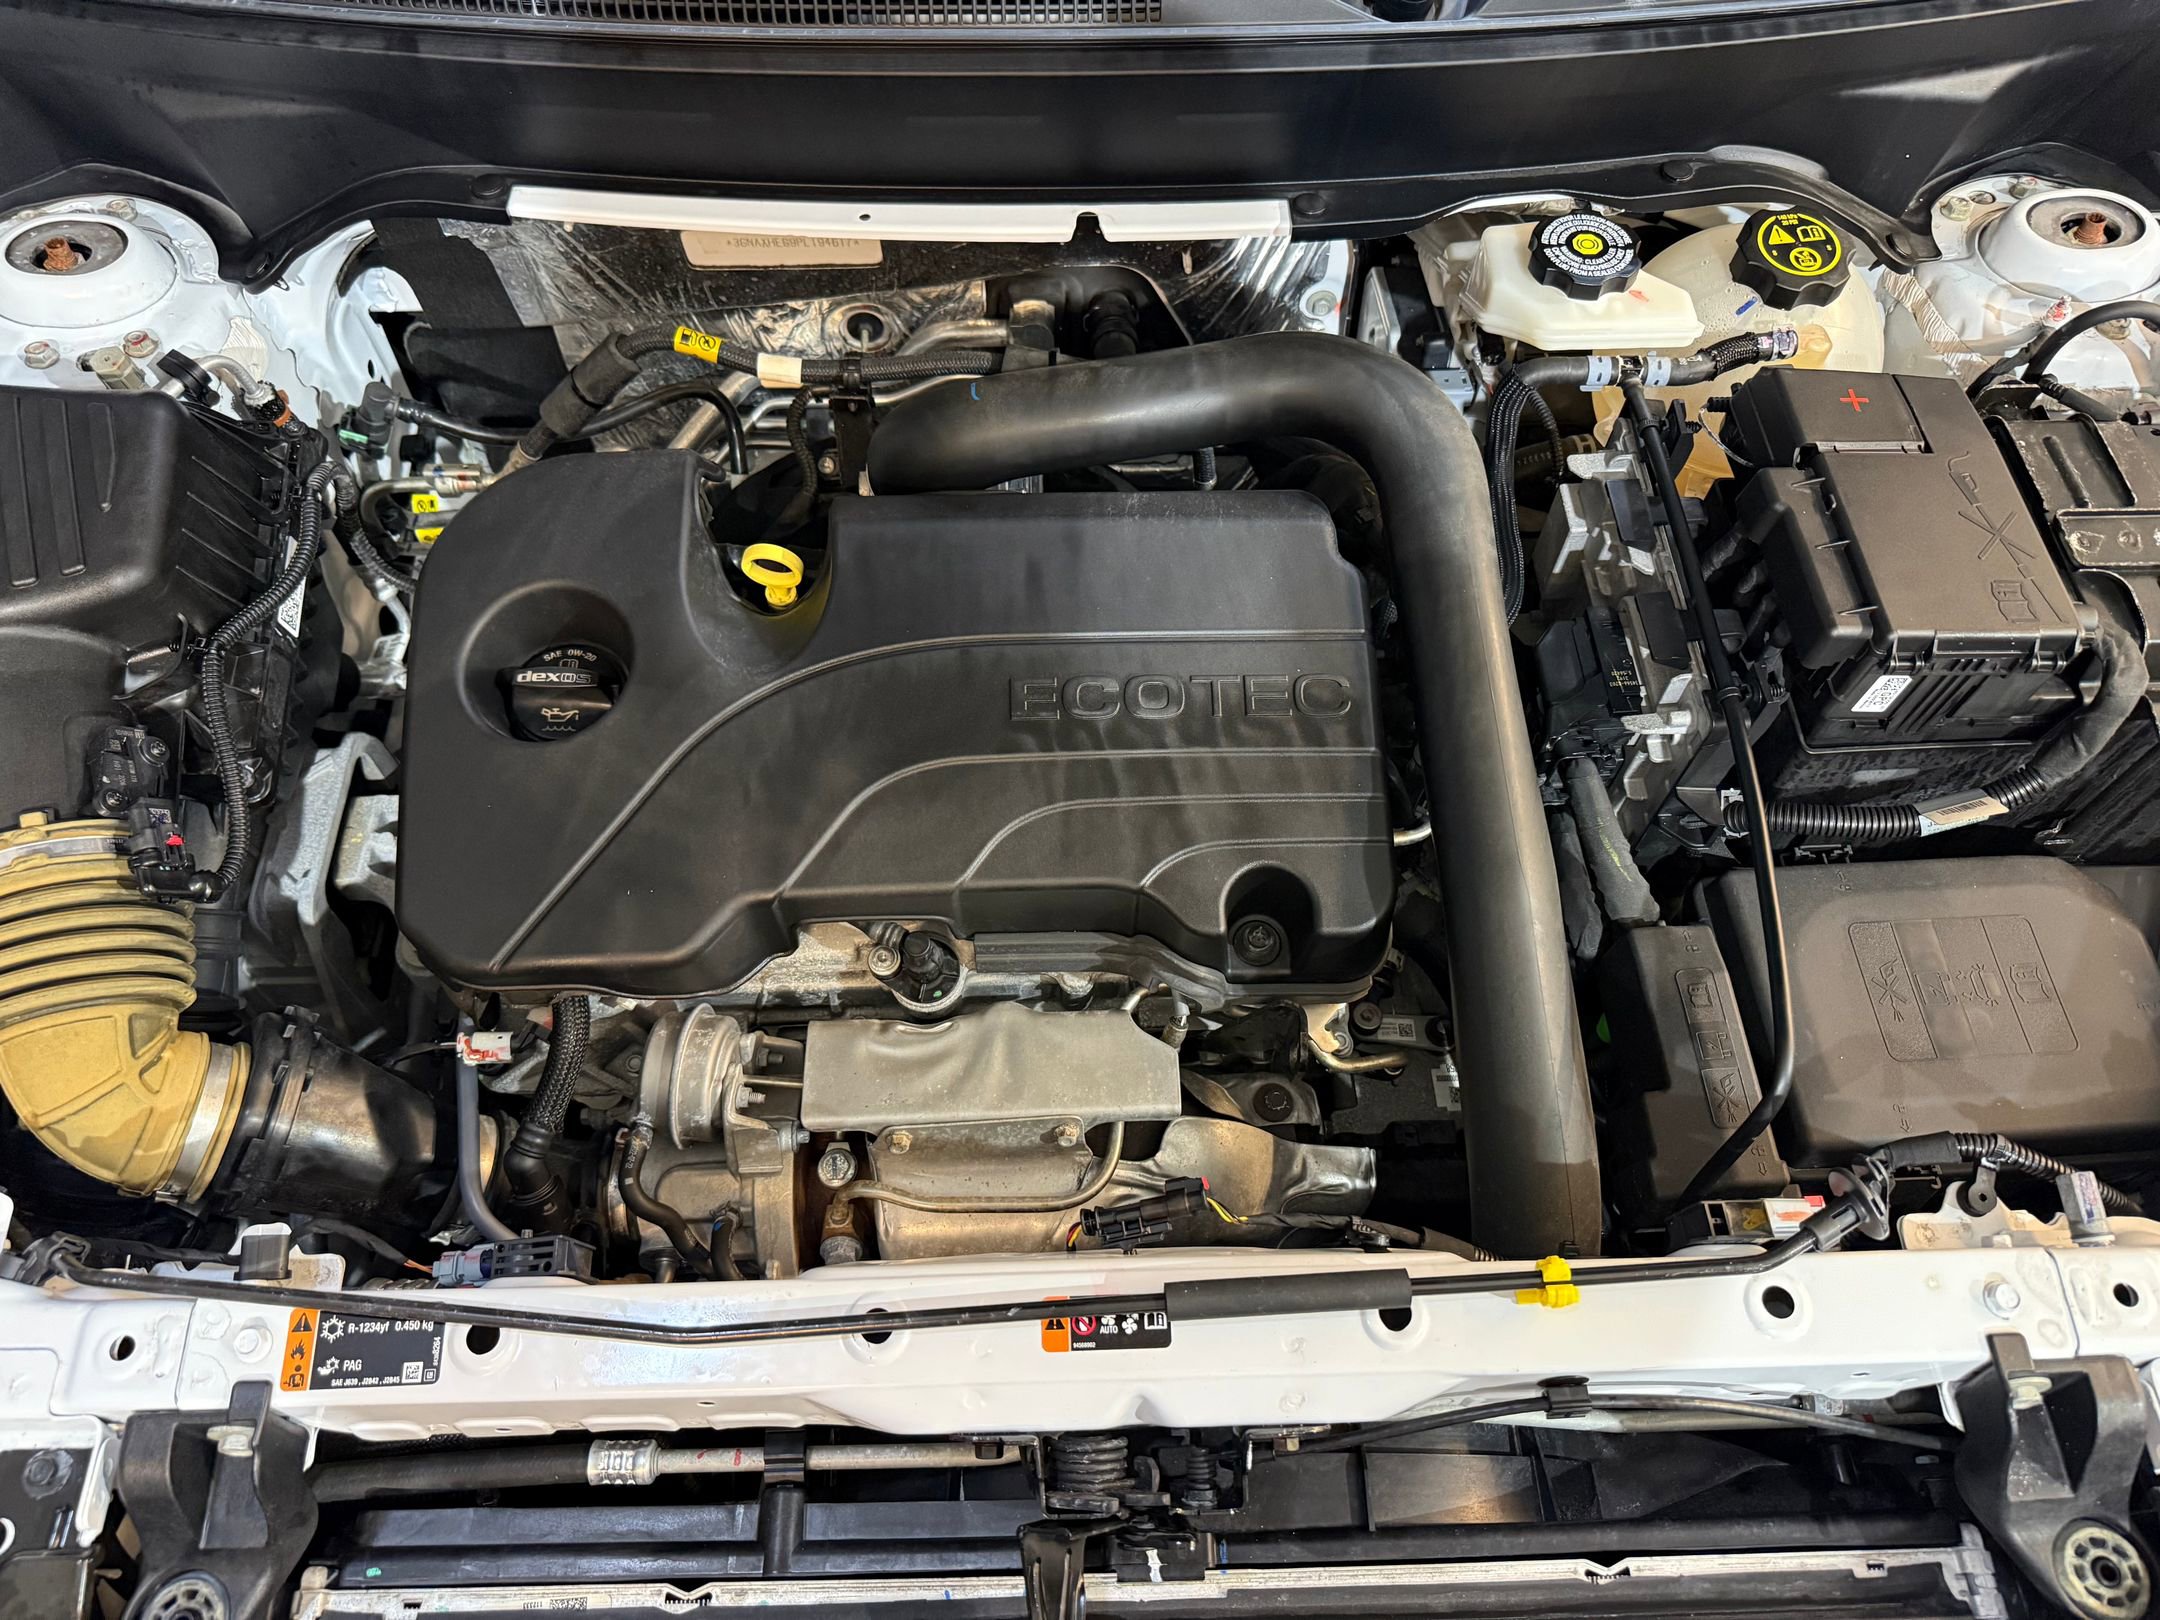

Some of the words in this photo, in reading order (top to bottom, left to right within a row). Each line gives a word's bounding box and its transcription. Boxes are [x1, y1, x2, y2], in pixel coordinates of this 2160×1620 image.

[543, 650, 562, 662] SAE
[567, 649, 598, 662] 0W-20
[517, 670, 592, 684] dexos
[1009, 673, 1351, 720] ECOTEC
[348, 1322, 390, 1334] R-1234yf
[394, 1321, 421, 1332] 0.450
[422, 1320, 434, 1332] kg
[1099, 1325, 1118, 1334] AUTO
[342, 1359, 362, 1371] PAG
